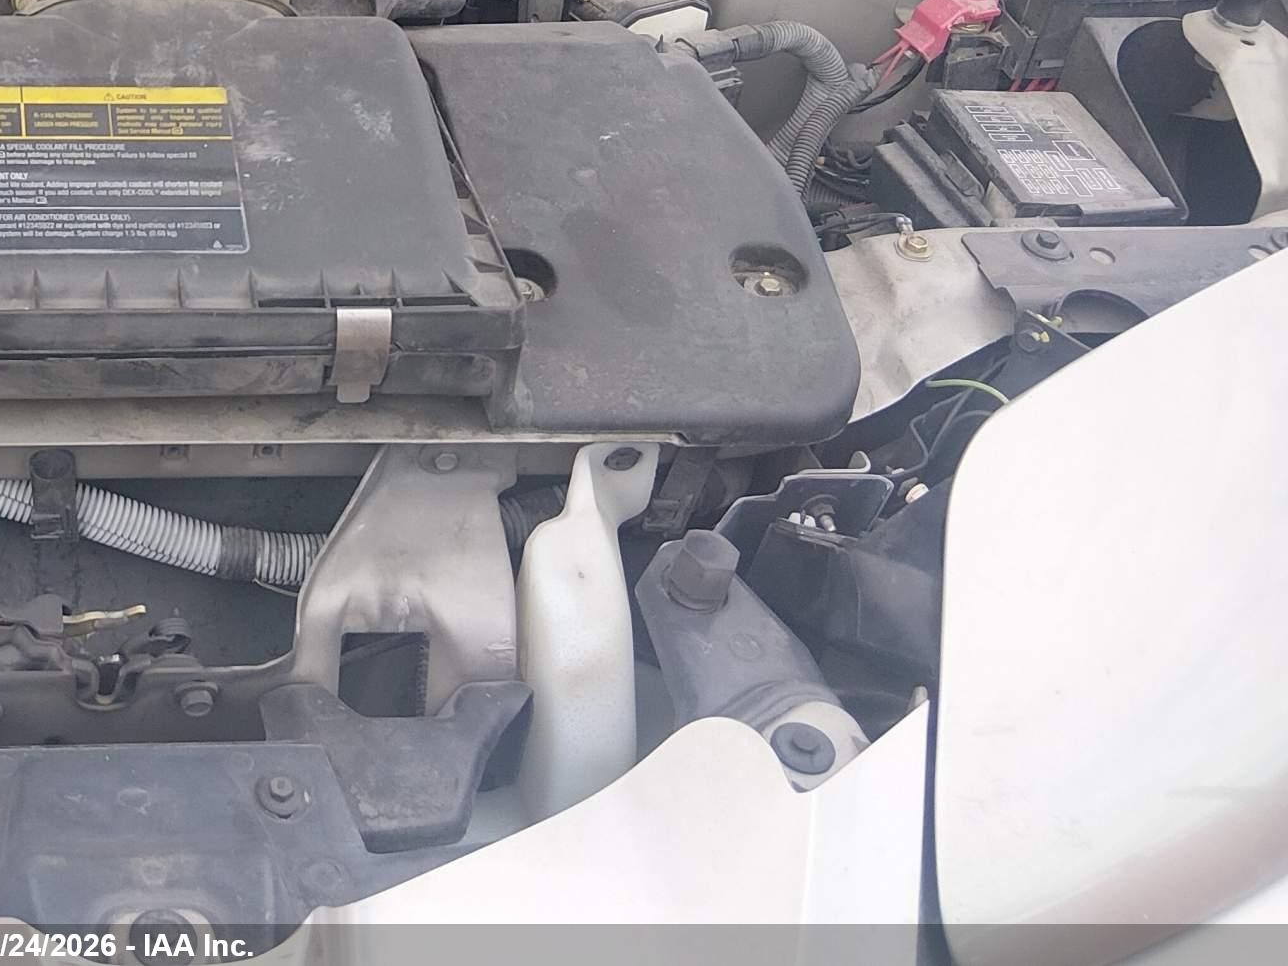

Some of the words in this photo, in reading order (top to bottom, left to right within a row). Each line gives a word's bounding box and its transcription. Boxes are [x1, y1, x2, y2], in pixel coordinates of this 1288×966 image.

[0, 143, 6, 151] A
[6, 143, 34, 151] SPECIAL
[35, 143, 68, 151] COOLANT
[68, 143, 83, 151] FILL
[84, 143, 126, 151] PROCEDURE
[9, 172, 29, 181] ONLY
[14, 214, 26, 222] AIR
[27, 214, 75, 222] CONDITIONED
[76, 214, 110, 222] VEHICLES
[110, 214, 132, 222] ONLY)
